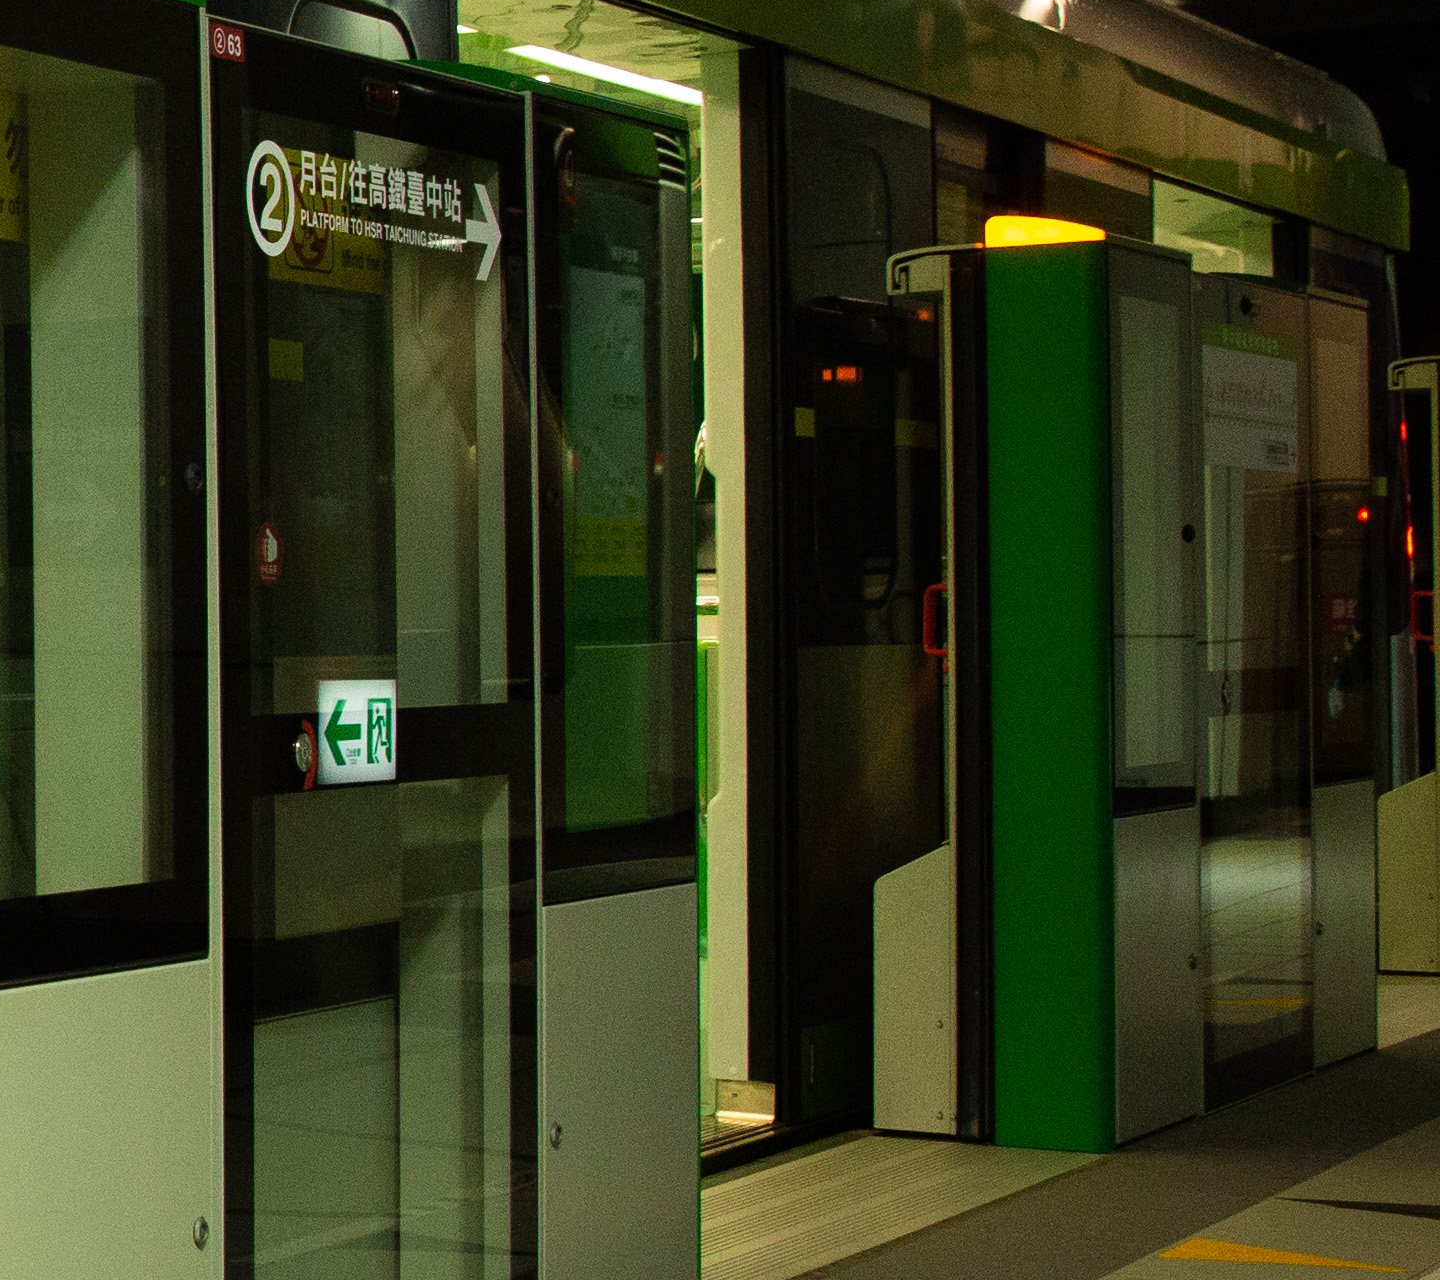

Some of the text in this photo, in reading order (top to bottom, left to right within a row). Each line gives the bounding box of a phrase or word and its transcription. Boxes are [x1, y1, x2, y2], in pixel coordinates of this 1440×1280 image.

[227, 33, 242, 57] 63
[299, 150, 462, 224] 月台/往高鐵臺中站
[300, 208, 349, 234] PLATFORM
[351, 217, 364, 236] TO
[364, 220, 383, 240] HSR
[384, 224, 427, 247] TAICHUNG
